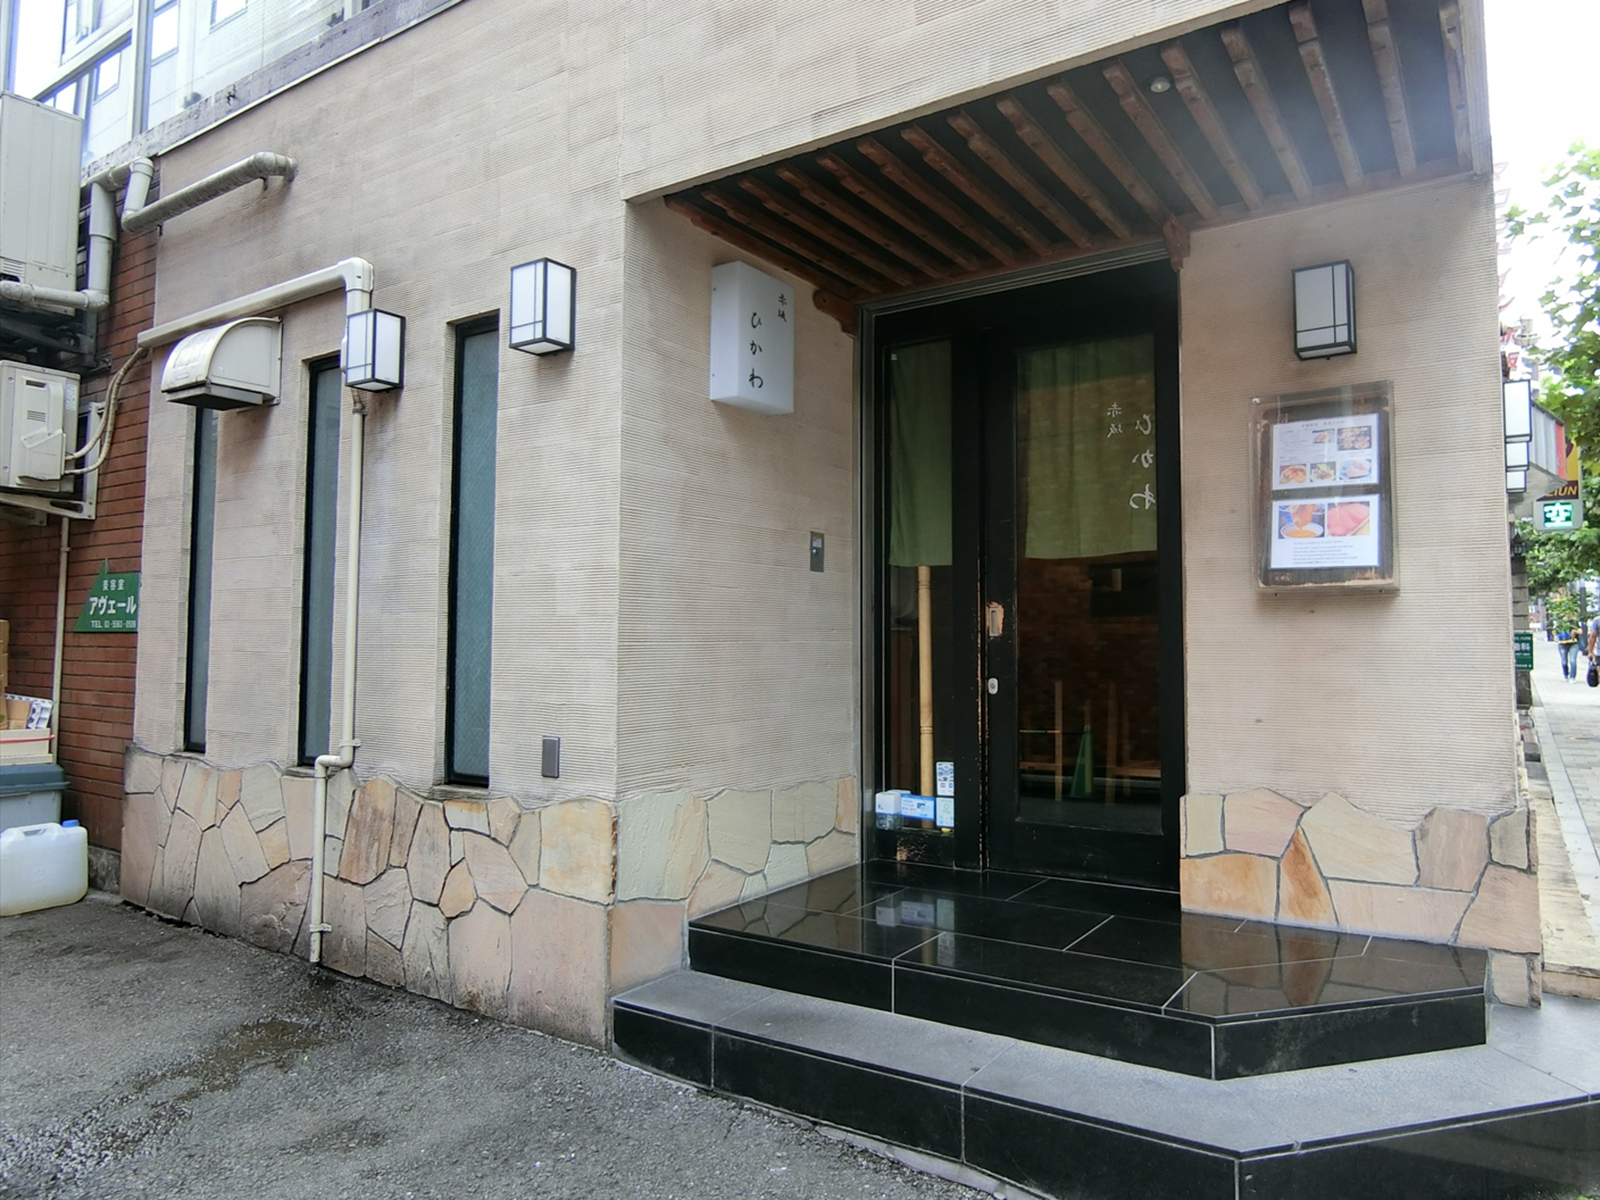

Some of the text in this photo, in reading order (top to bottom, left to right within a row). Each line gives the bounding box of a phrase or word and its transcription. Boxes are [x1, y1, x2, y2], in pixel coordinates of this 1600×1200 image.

[748, 312, 764, 389] ひかわ
[102, 579, 125, 591] 美容室
[90, 595, 137, 615] アヴェール
[91, 620, 102, 628] TEL
